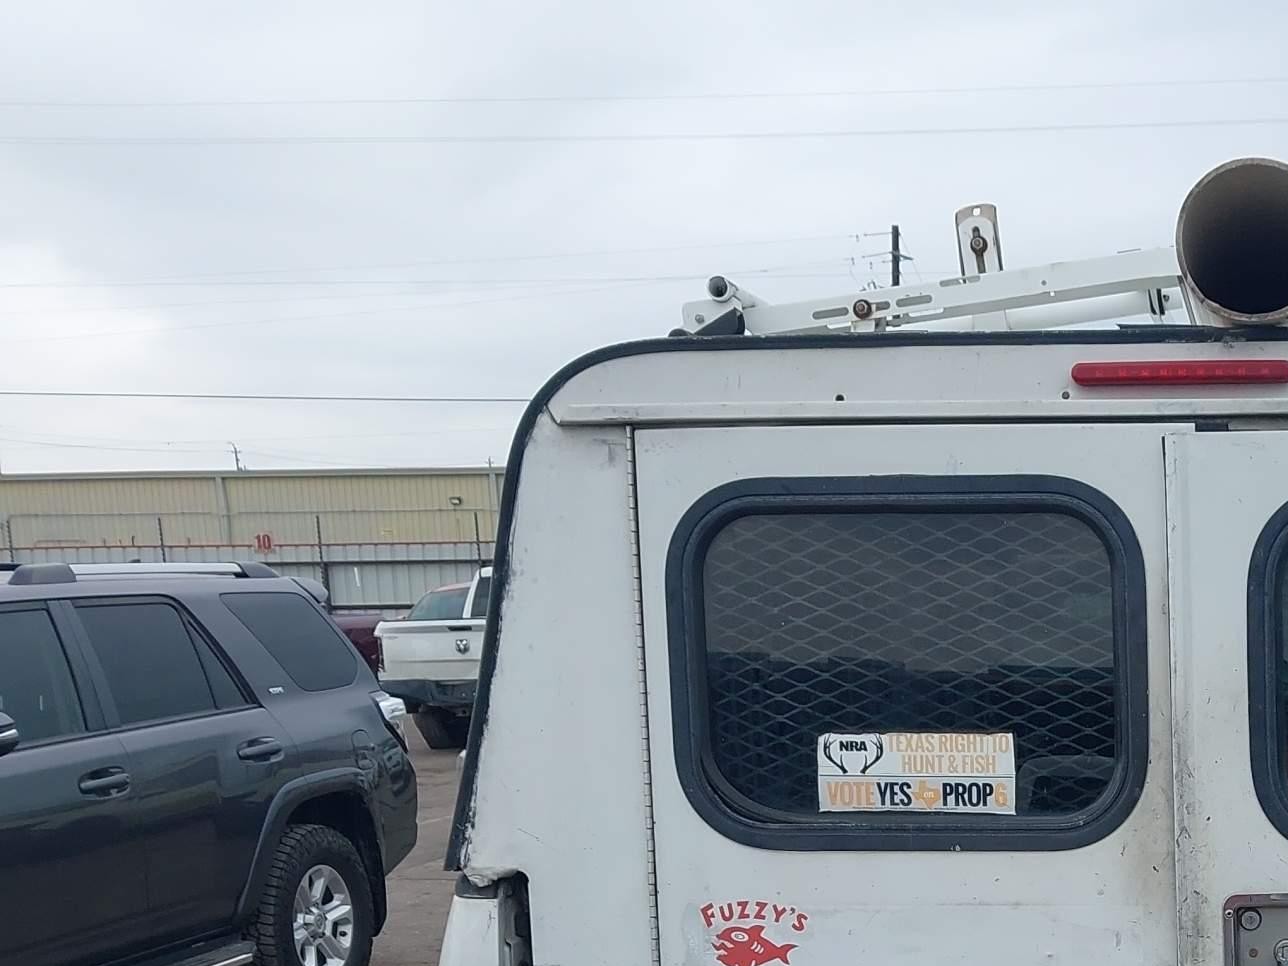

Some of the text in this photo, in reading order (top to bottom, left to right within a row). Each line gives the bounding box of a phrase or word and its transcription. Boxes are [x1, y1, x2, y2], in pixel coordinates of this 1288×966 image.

[255, 534, 272, 550] 10
[839, 740, 868, 752] NRA
[887, 734, 1010, 753] TEXAS RIGHT TO
[902, 754, 996, 774] HUNT & FISH
[827, 781, 875, 806] VOTE
[876, 782, 913, 806] YES
[942, 783, 994, 807] PROP
[700, 901, 809, 931] FUZZY'S
